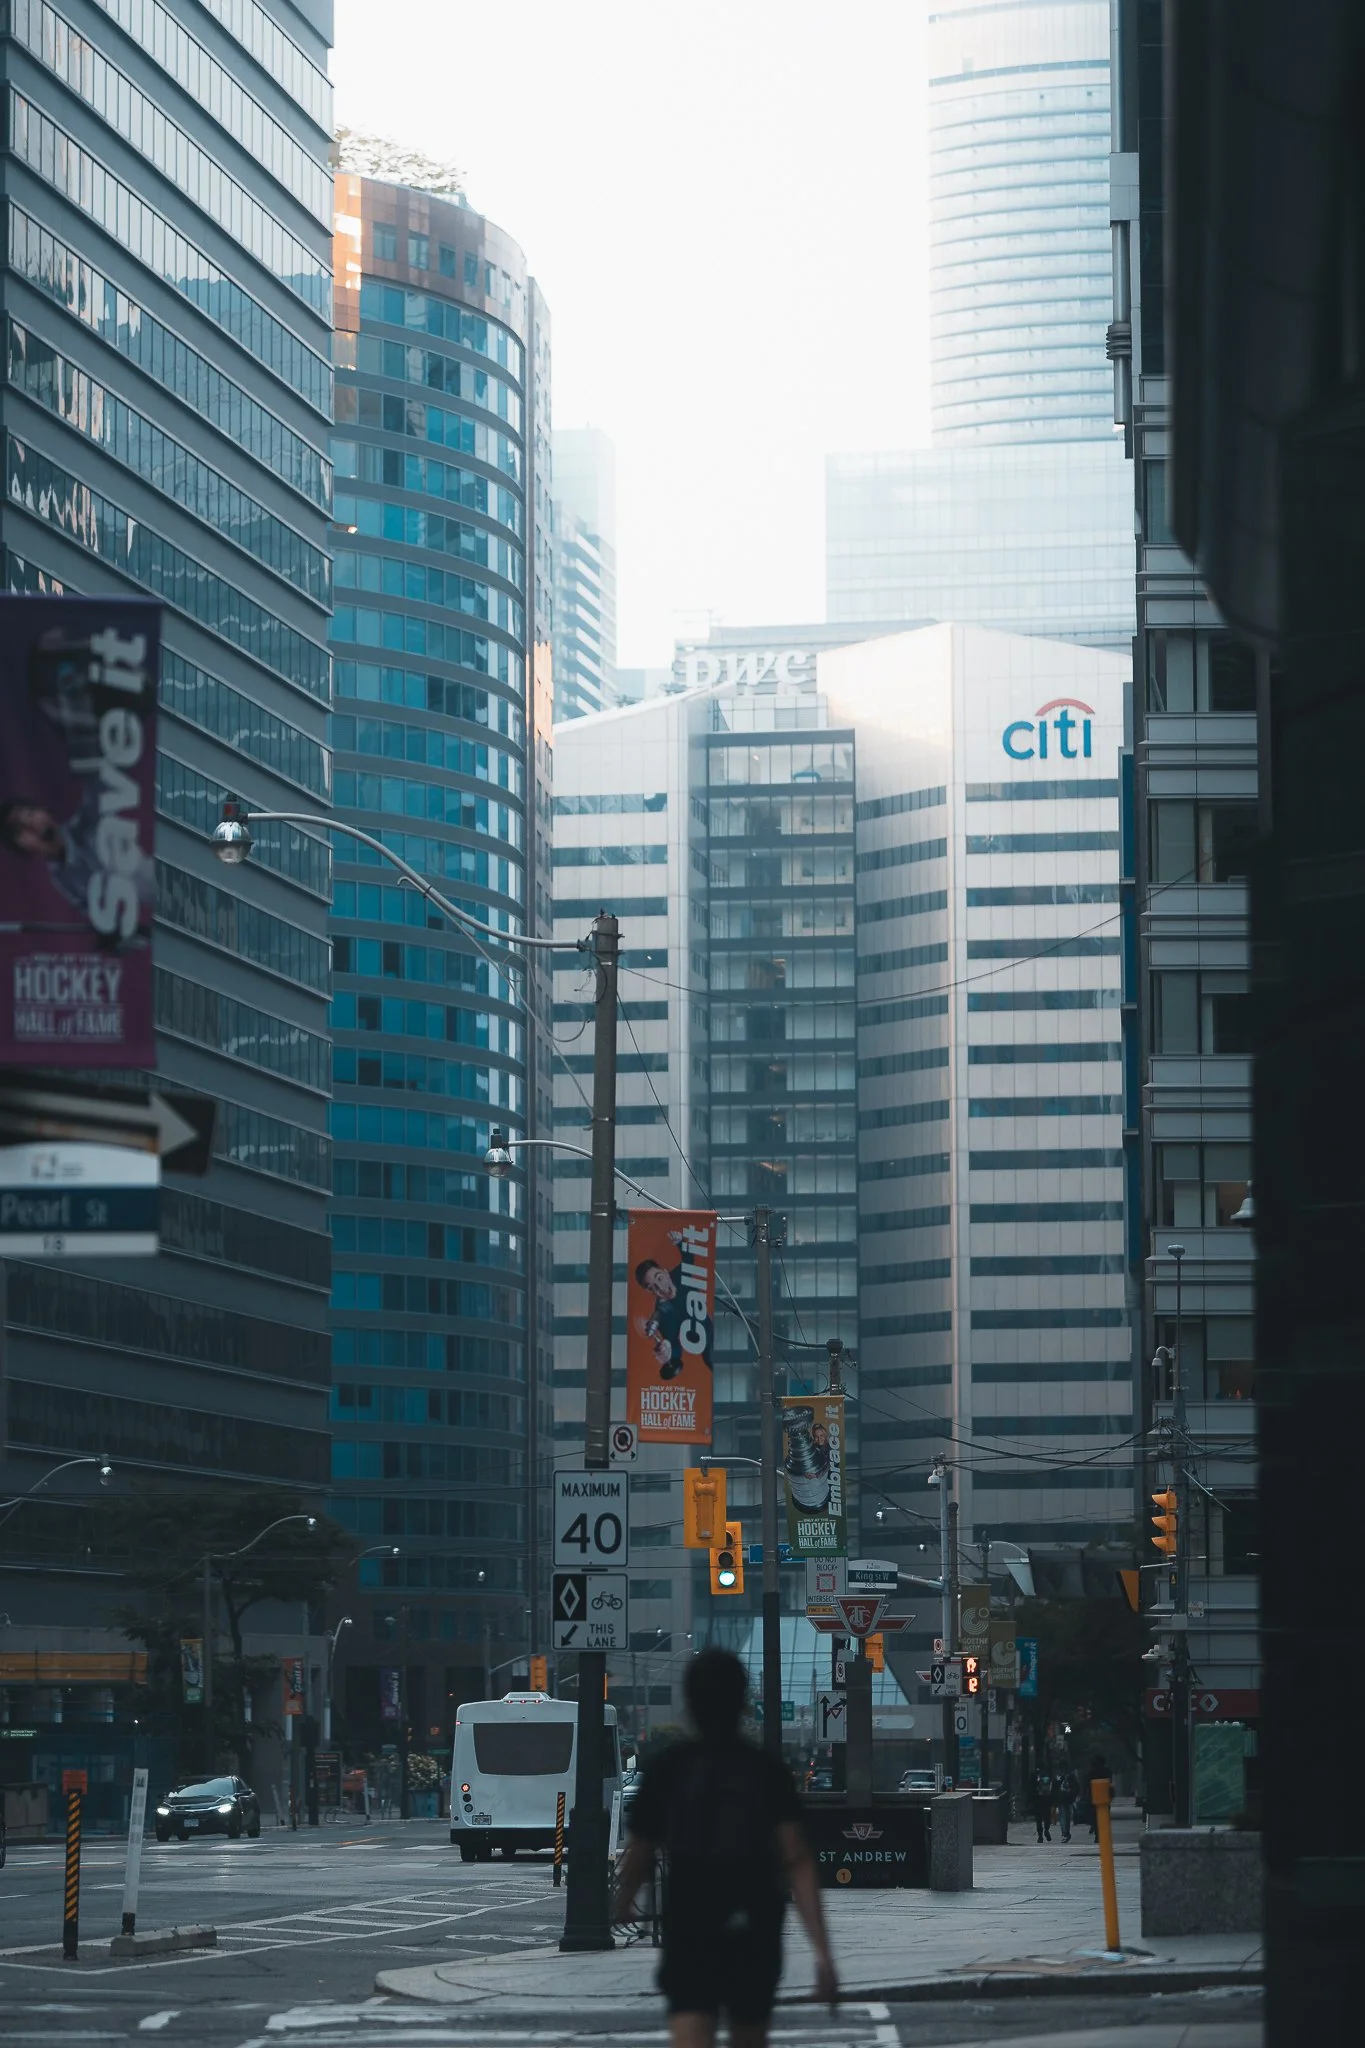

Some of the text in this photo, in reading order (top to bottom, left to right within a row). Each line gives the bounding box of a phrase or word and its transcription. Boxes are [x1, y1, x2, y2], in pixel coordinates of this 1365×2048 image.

[683, 651, 808, 688] pwc
[1002, 709, 1092, 760] citi
[87, 626, 146, 940] Save it
[14, 965, 122, 1002] HOCKEY
[680, 1224, 709, 1355] Call it
[641, 1391, 696, 1411] HOCKEY
[641, 1413, 696, 1427] HALL of FAME
[825, 1404, 842, 1517] Embrace it
[561, 1482, 620, 1497] MAXIMUM
[561, 1512, 622, 1554] 40
[797, 1522, 837, 1536] HOCKEY
[798, 1536, 814, 1547] HALL
[821, 1536, 837, 1547] FAME
[855, 1571, 874, 1583] King
[882, 1572, 890, 1581] W
[589, 1623, 614, 1635] THIS
[586, 1637, 617, 1648] LANE
[956, 1716, 966, 1730] 0
[819, 1851, 907, 1862] ST ANDREW
